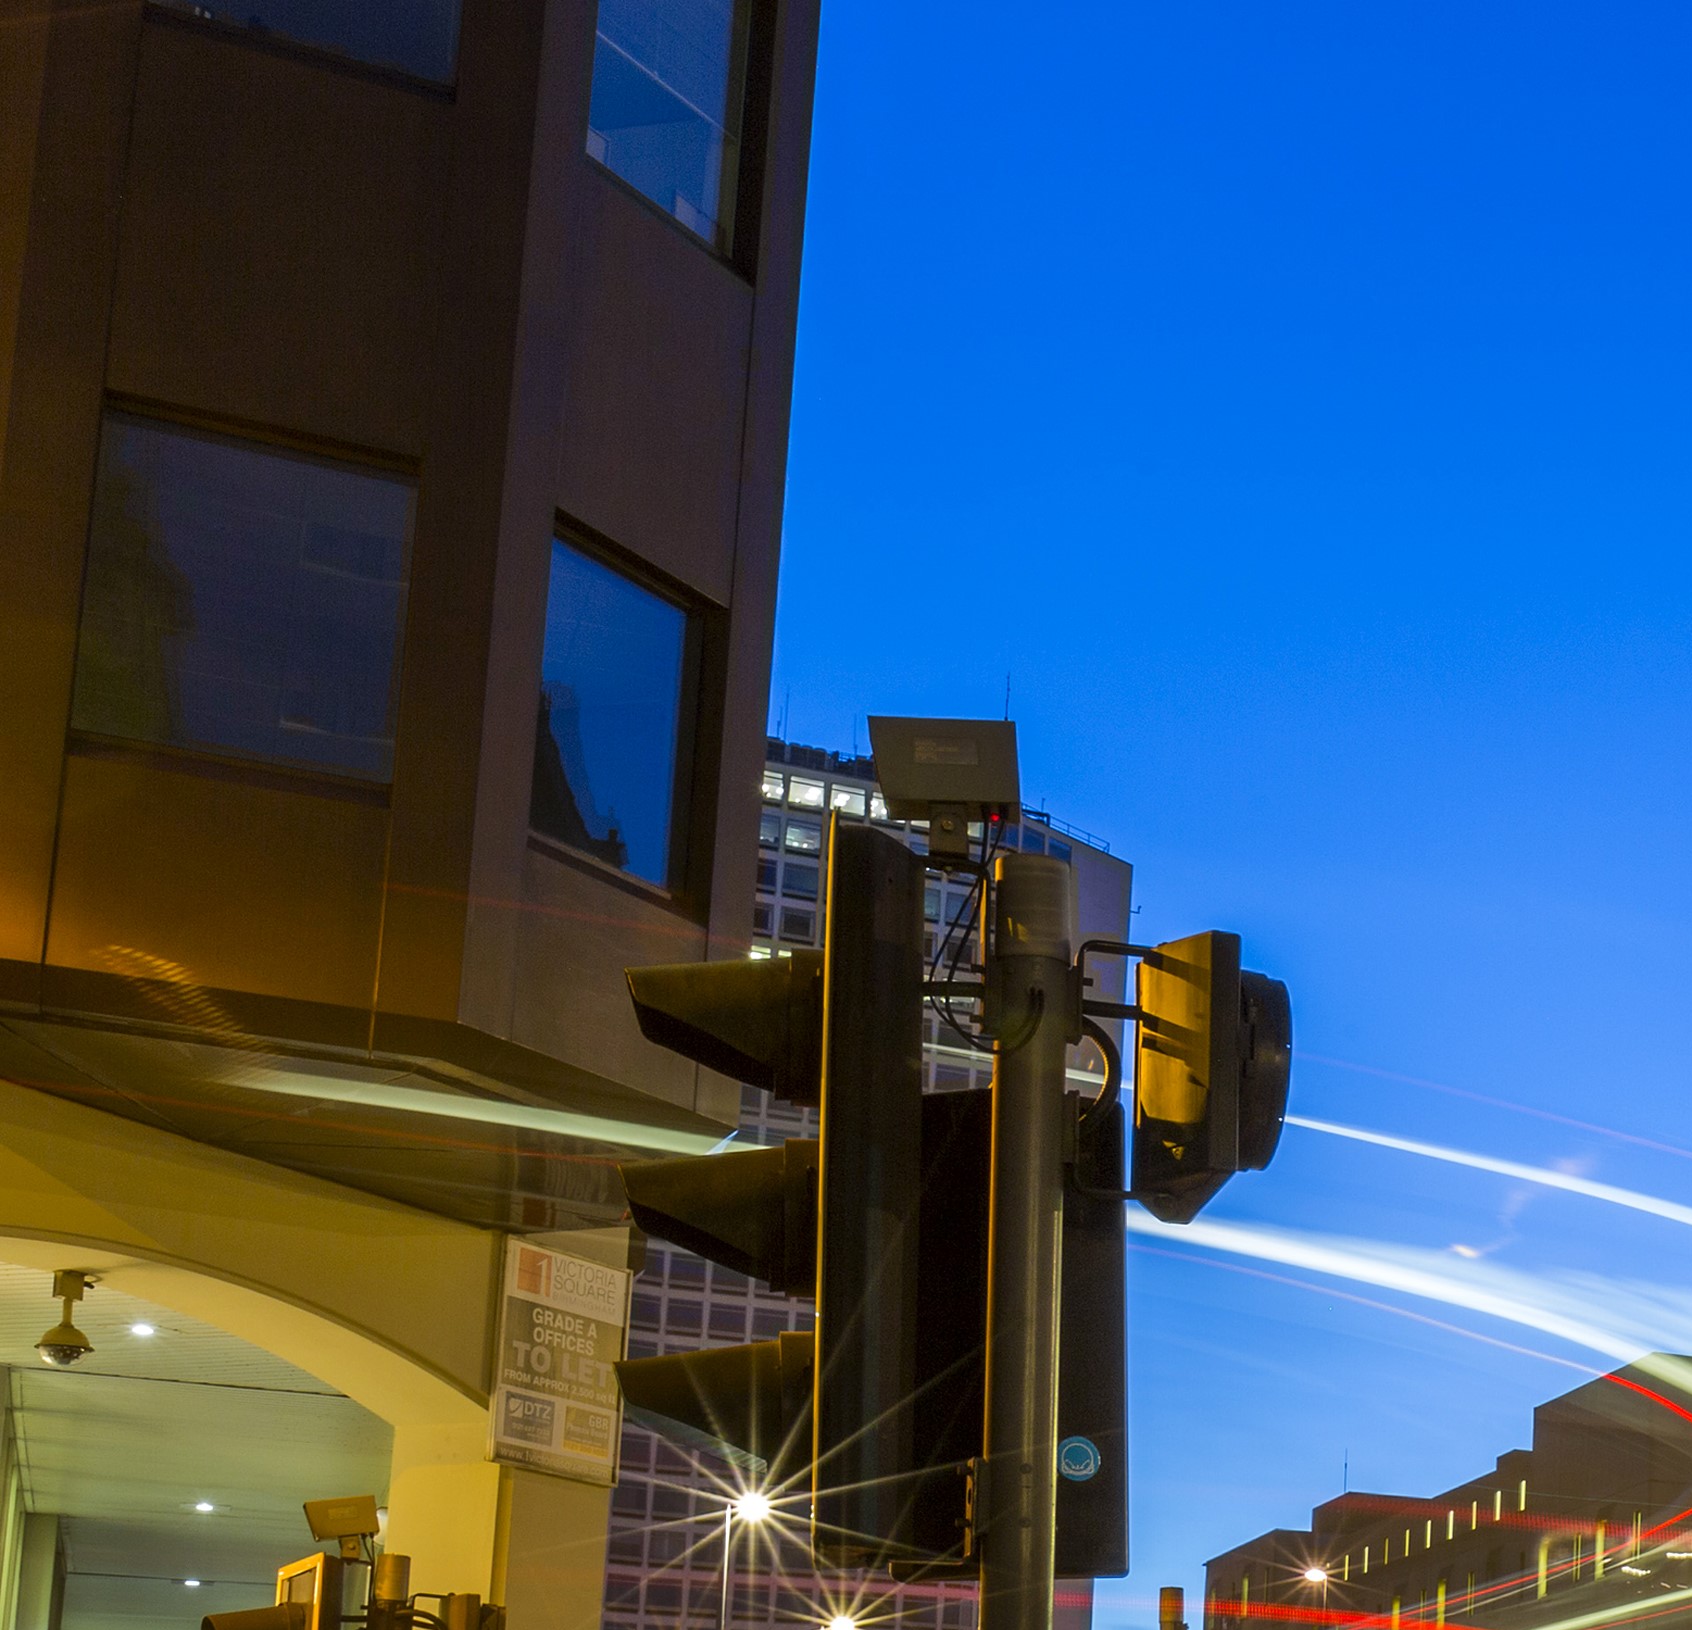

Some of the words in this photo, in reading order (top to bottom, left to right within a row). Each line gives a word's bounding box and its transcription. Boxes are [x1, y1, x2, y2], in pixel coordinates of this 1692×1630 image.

[554, 1256, 617, 1289] VICTORIA
[554, 1275, 616, 1306] SQUARE
[532, 1308, 584, 1335] GRADE
[588, 1323, 598, 1339] A
[533, 1327, 595, 1356] OFFICES
[512, 1340, 551, 1373] TO
[562, 1352, 611, 1388] LET
[504, 1368, 531, 1384] FROM
[532, 1376, 569, 1395] APPROX
[524, 1401, 552, 1420] DTZ
